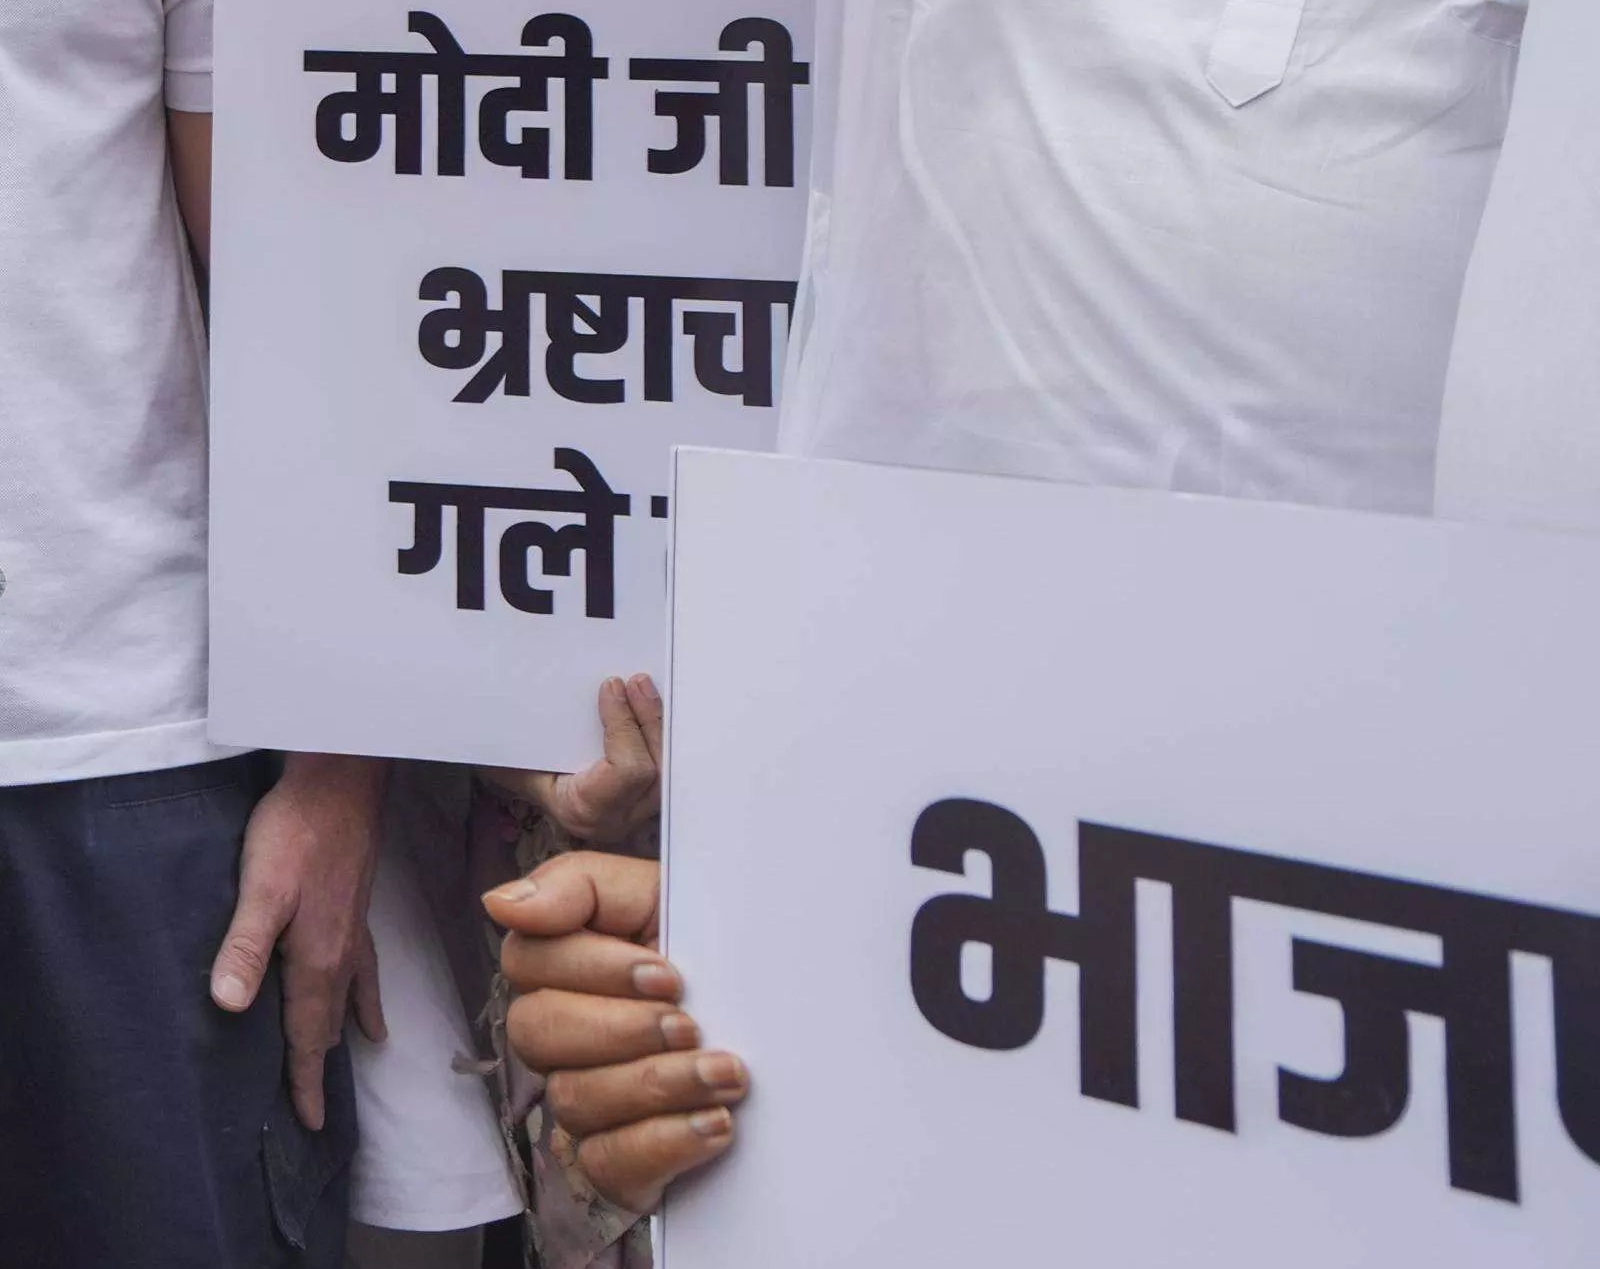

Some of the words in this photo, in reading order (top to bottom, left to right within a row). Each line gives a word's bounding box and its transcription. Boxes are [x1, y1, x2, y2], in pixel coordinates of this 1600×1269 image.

[303, 10, 609, 181] मोदी
[629, 17, 810, 189] जी
[417, 265, 799, 409] भ्रष्टाच
[388, 446, 631, 620] गले
[910, 796, 1600, 1206] भाज
